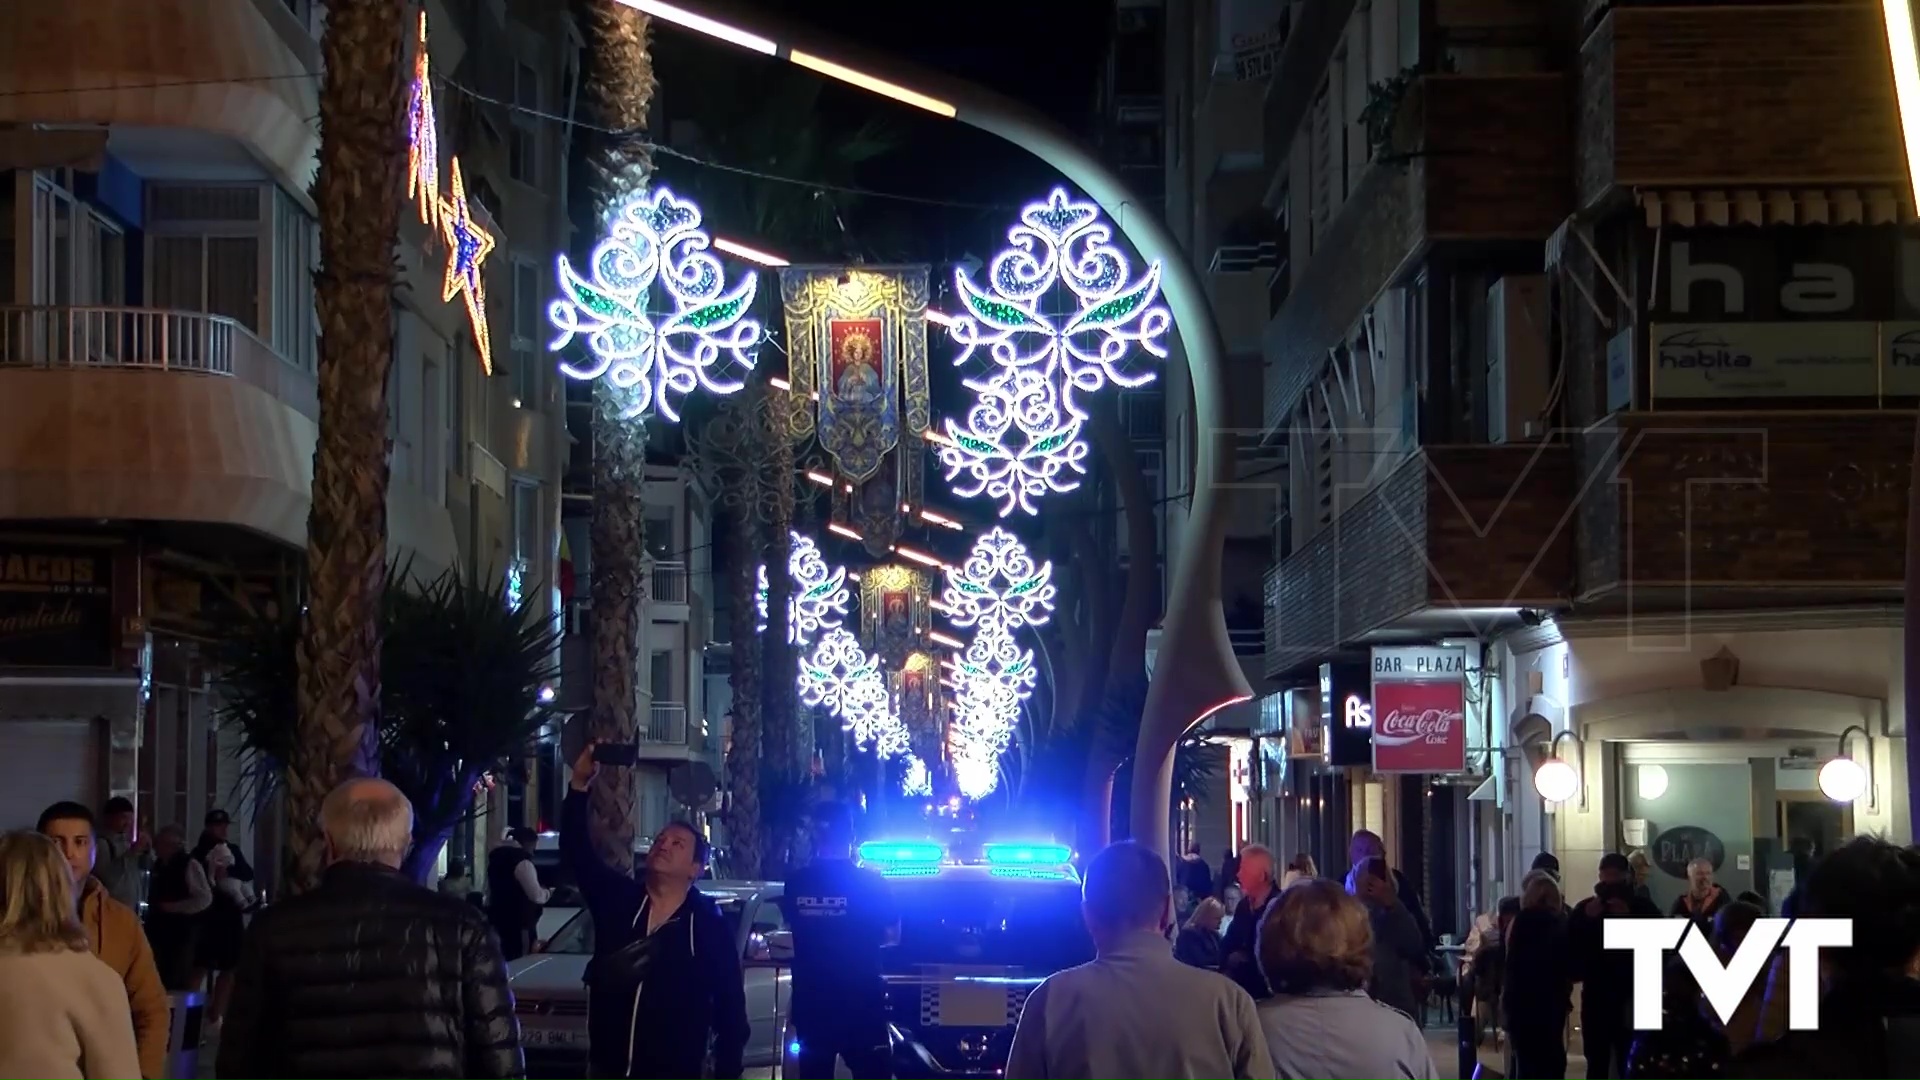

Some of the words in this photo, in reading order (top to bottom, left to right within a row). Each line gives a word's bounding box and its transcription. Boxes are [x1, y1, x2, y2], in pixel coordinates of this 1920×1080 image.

[1670, 240, 1920, 313] ha
[1659, 351, 1752, 368] habita
[1375, 657, 1402, 673] BAR
[1417, 656, 1463, 673] PLAZA
[1425, 733, 1449, 744] Coke
